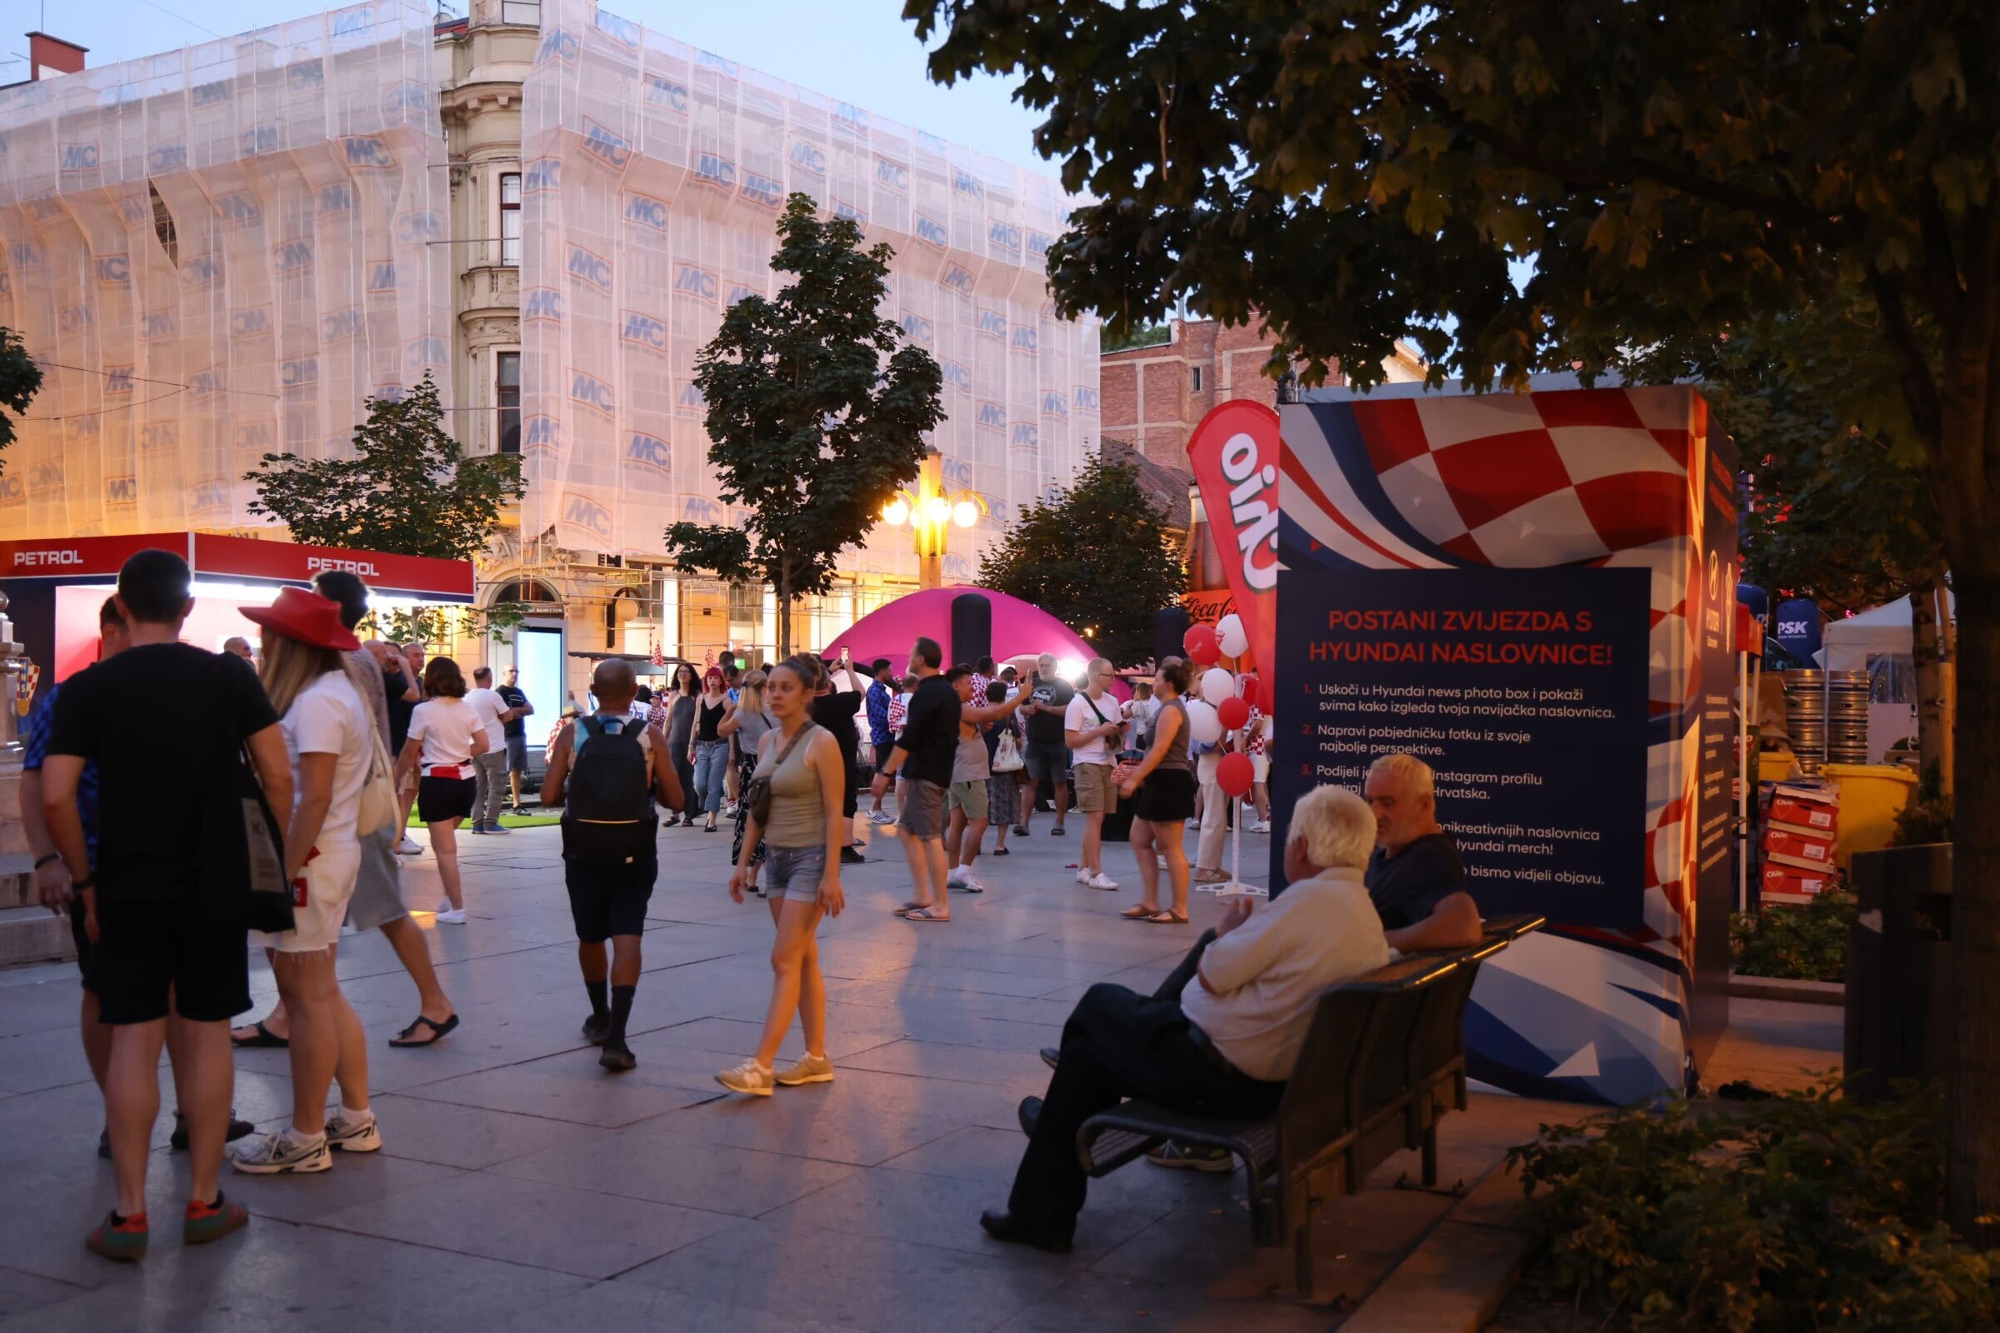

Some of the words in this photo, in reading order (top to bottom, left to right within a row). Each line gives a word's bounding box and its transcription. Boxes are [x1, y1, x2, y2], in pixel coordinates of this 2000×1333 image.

[537, 28, 578, 64] MC
[648, 80, 687, 111] MC
[62, 145, 97, 168] MC
[346, 138, 391, 164] MC
[584, 126, 629, 165] MC
[791, 140, 825, 173] MC
[524, 160, 561, 190] MC
[694, 155, 733, 187] MC
[877, 160, 907, 190] MC
[741, 175, 780, 206] MC
[955, 172, 983, 200] MC
[625, 197, 667, 227] MC
[917, 217, 946, 246] MC
[990, 223, 1018, 249] MC
[568, 248, 610, 287] MC
[945, 267, 973, 293] MC
[675, 266, 715, 299] MC
[525, 290, 566, 319] MC
[624, 315, 665, 347] MC
[903, 314, 932, 342] MC
[980, 311, 1006, 337] MC
[1012, 327, 1037, 350] MC
[943, 361, 970, 389] MC
[572, 374, 613, 411] MC
[1043, 391, 1068, 415] MC
[1074, 387, 1098, 409] MC
[980, 403, 1006, 428] MC
[526, 416, 567, 449] MC
[1012, 423, 1037, 446] MC
[627, 434, 668, 466] MC
[942, 457, 970, 485] MC
[565, 497, 609, 536] MC
[683, 497, 720, 525] MC
[14, 550, 84, 566] PETROL
[308, 557, 380, 577] PETROL
[1328, 610, 1436, 631] POSTANI
[1442, 610, 1571, 632] ZVIJEZDA
[1575, 610, 1592, 632] S
[1778, 621, 1808, 635] PSK
[1309, 641, 1425, 663] HYUNDAI
[1432, 642, 1613, 666] NASLOVNICE!
[1319, 683, 1359, 695] Uskoči
[1361, 686, 1369, 695] u
[1372, 685, 1425, 698] Hyundai
[1428, 688, 1461, 698] news
[1464, 687, 1502, 700] photo
[1505, 688, 1530, 699] box
[1532, 688, 1536, 699] i
[1539, 688, 1583, 702] pokaži
[1319, 700, 1356, 711] svima
[1358, 700, 1388, 712] kako
[1390, 701, 1435, 715] izgleda
[1438, 704, 1470, 716] tvoja
[1473, 704, 1536, 717] navijačka
[1539, 706, 1616, 719] naslovnica.
[1317, 725, 1366, 738] Napravi
[1369, 726, 1446, 740] pobjedničku
[1449, 728, 1481, 741] fotku
[1484, 729, 1494, 741] iz
[1497, 731, 1531, 744] svoje
[1319, 740, 1368, 753] najbolje
[1370, 743, 1445, 756] perspektive.
[1317, 764, 1359, 778] Podijeli
[1362, 766, 1372, 779] je
[1432, 770, 1498, 784] Instagram
[1501, 773, 1543, 786] profilu
[1528, 827, 1600, 841] naslovnica
[1508, 842, 1554, 855] merch!
[1471, 865, 1511, 879] bismo
[1514, 867, 1551, 883] vidjeli
[1554, 871, 1605, 885] objavu.
